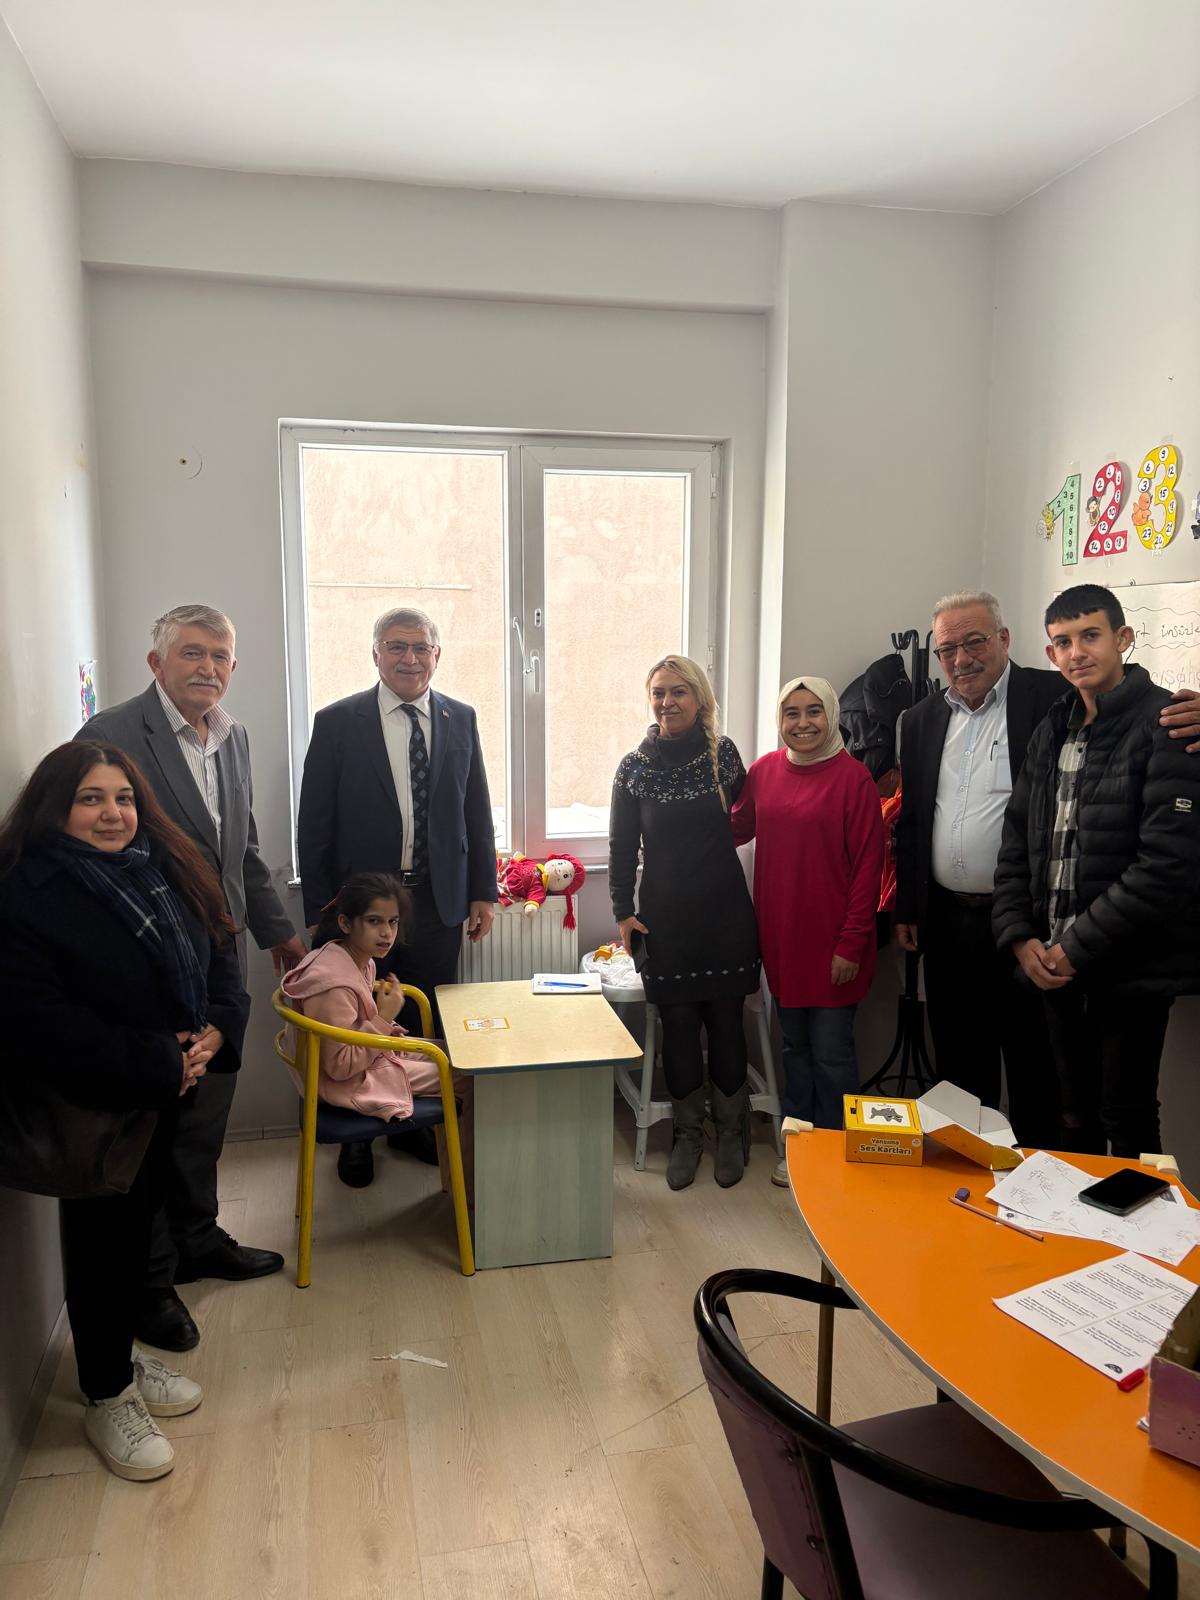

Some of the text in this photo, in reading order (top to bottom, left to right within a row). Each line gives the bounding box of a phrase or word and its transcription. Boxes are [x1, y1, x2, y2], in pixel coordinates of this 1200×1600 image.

[1159, 489, 1167, 498] 15
[1047, 473, 1081, 566] 1
[1083, 462, 1128, 558] 2
[1142, 529, 1152, 538] 27
[860, 1144, 912, 1155] Ses Kartları
